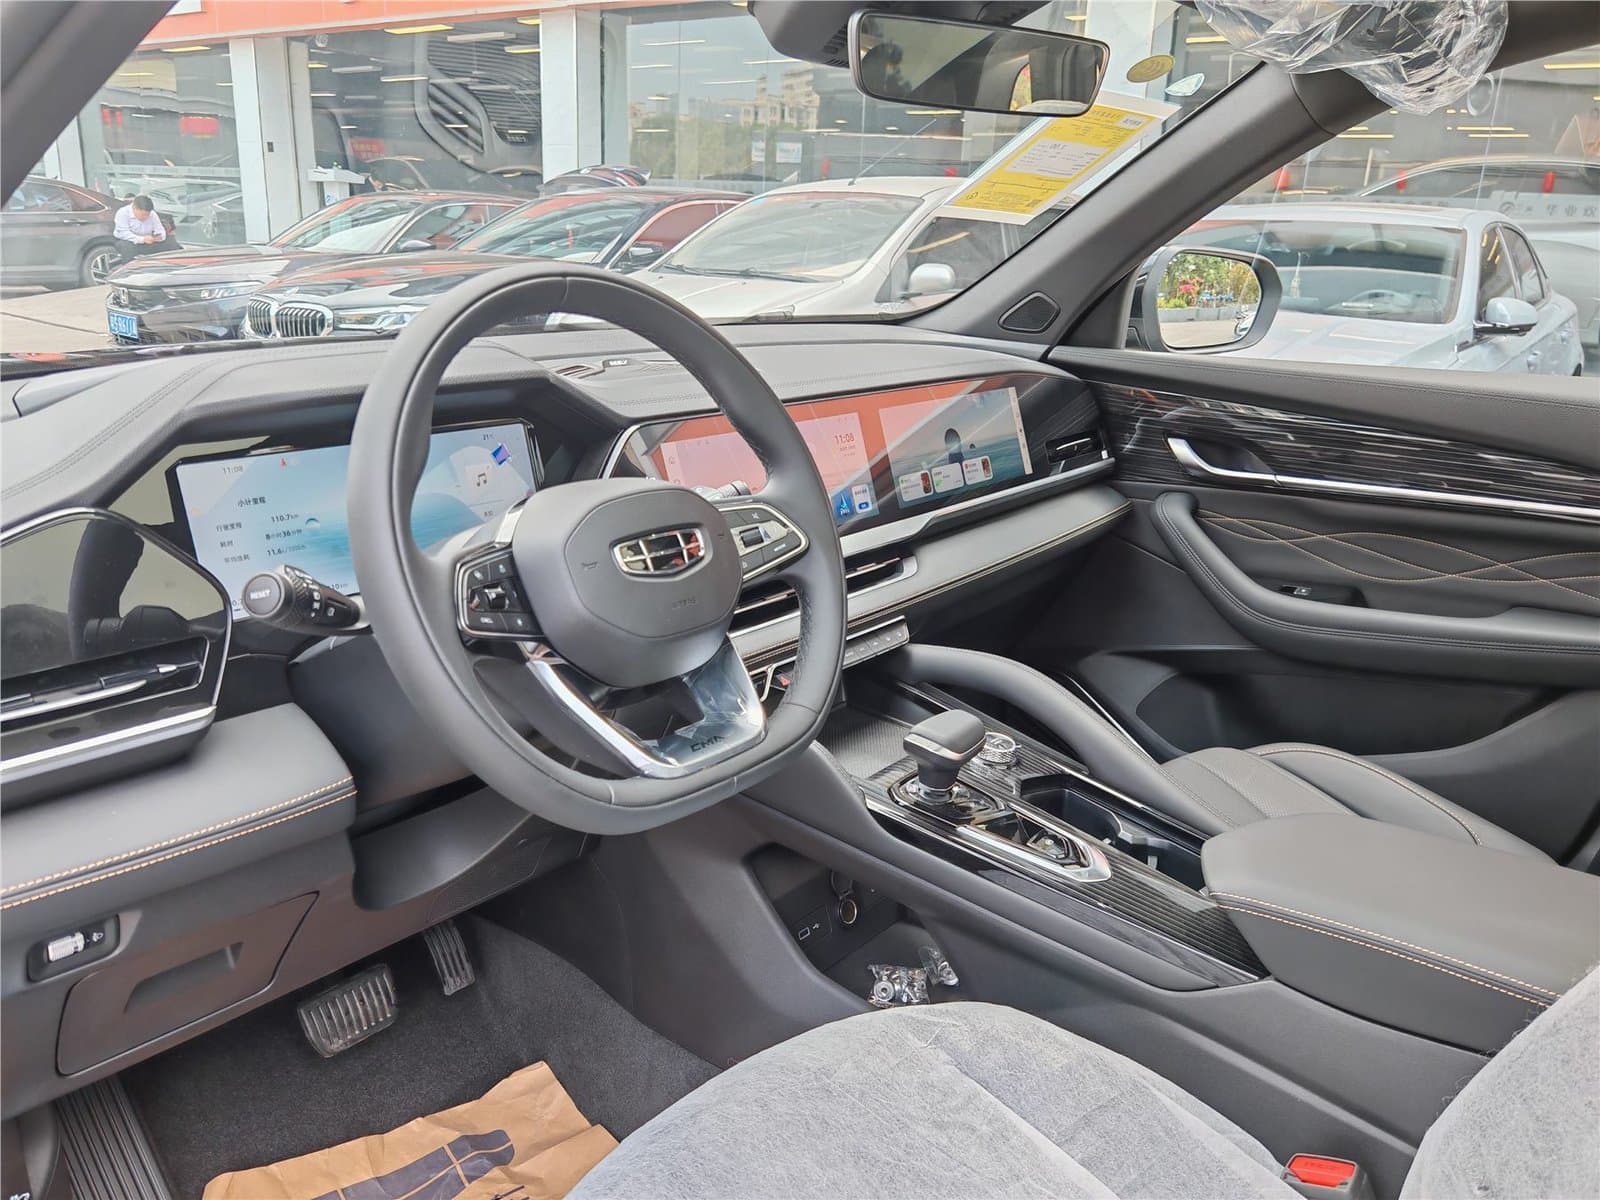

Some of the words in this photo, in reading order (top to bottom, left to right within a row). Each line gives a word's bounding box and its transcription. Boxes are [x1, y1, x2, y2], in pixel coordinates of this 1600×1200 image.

[834, 433, 855, 444] 11:08
[223, 465, 244, 474] 11:08
[237, 496, 266, 508] 小计里程
[250, 589, 271, 600] RESET
